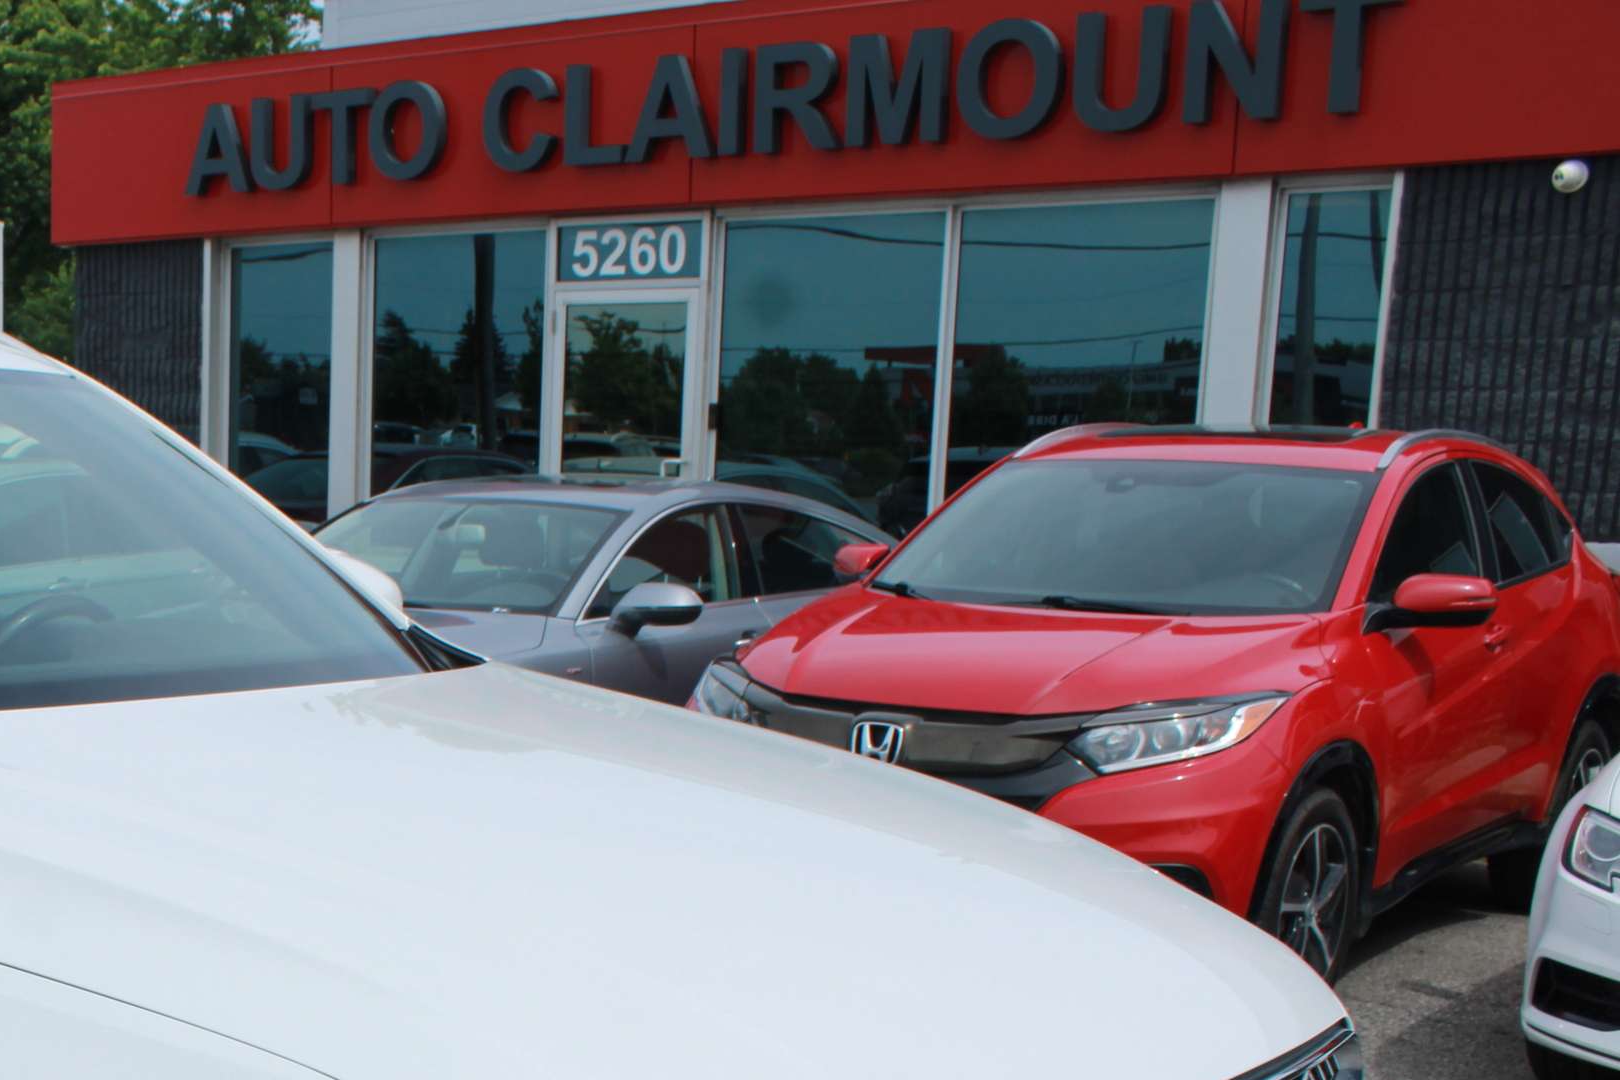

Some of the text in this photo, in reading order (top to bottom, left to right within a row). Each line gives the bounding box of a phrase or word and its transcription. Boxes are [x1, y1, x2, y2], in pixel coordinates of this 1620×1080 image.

[185, 0, 1402, 197] AUTO CLAIRMOUNT
[571, 225, 687, 278] 5260
